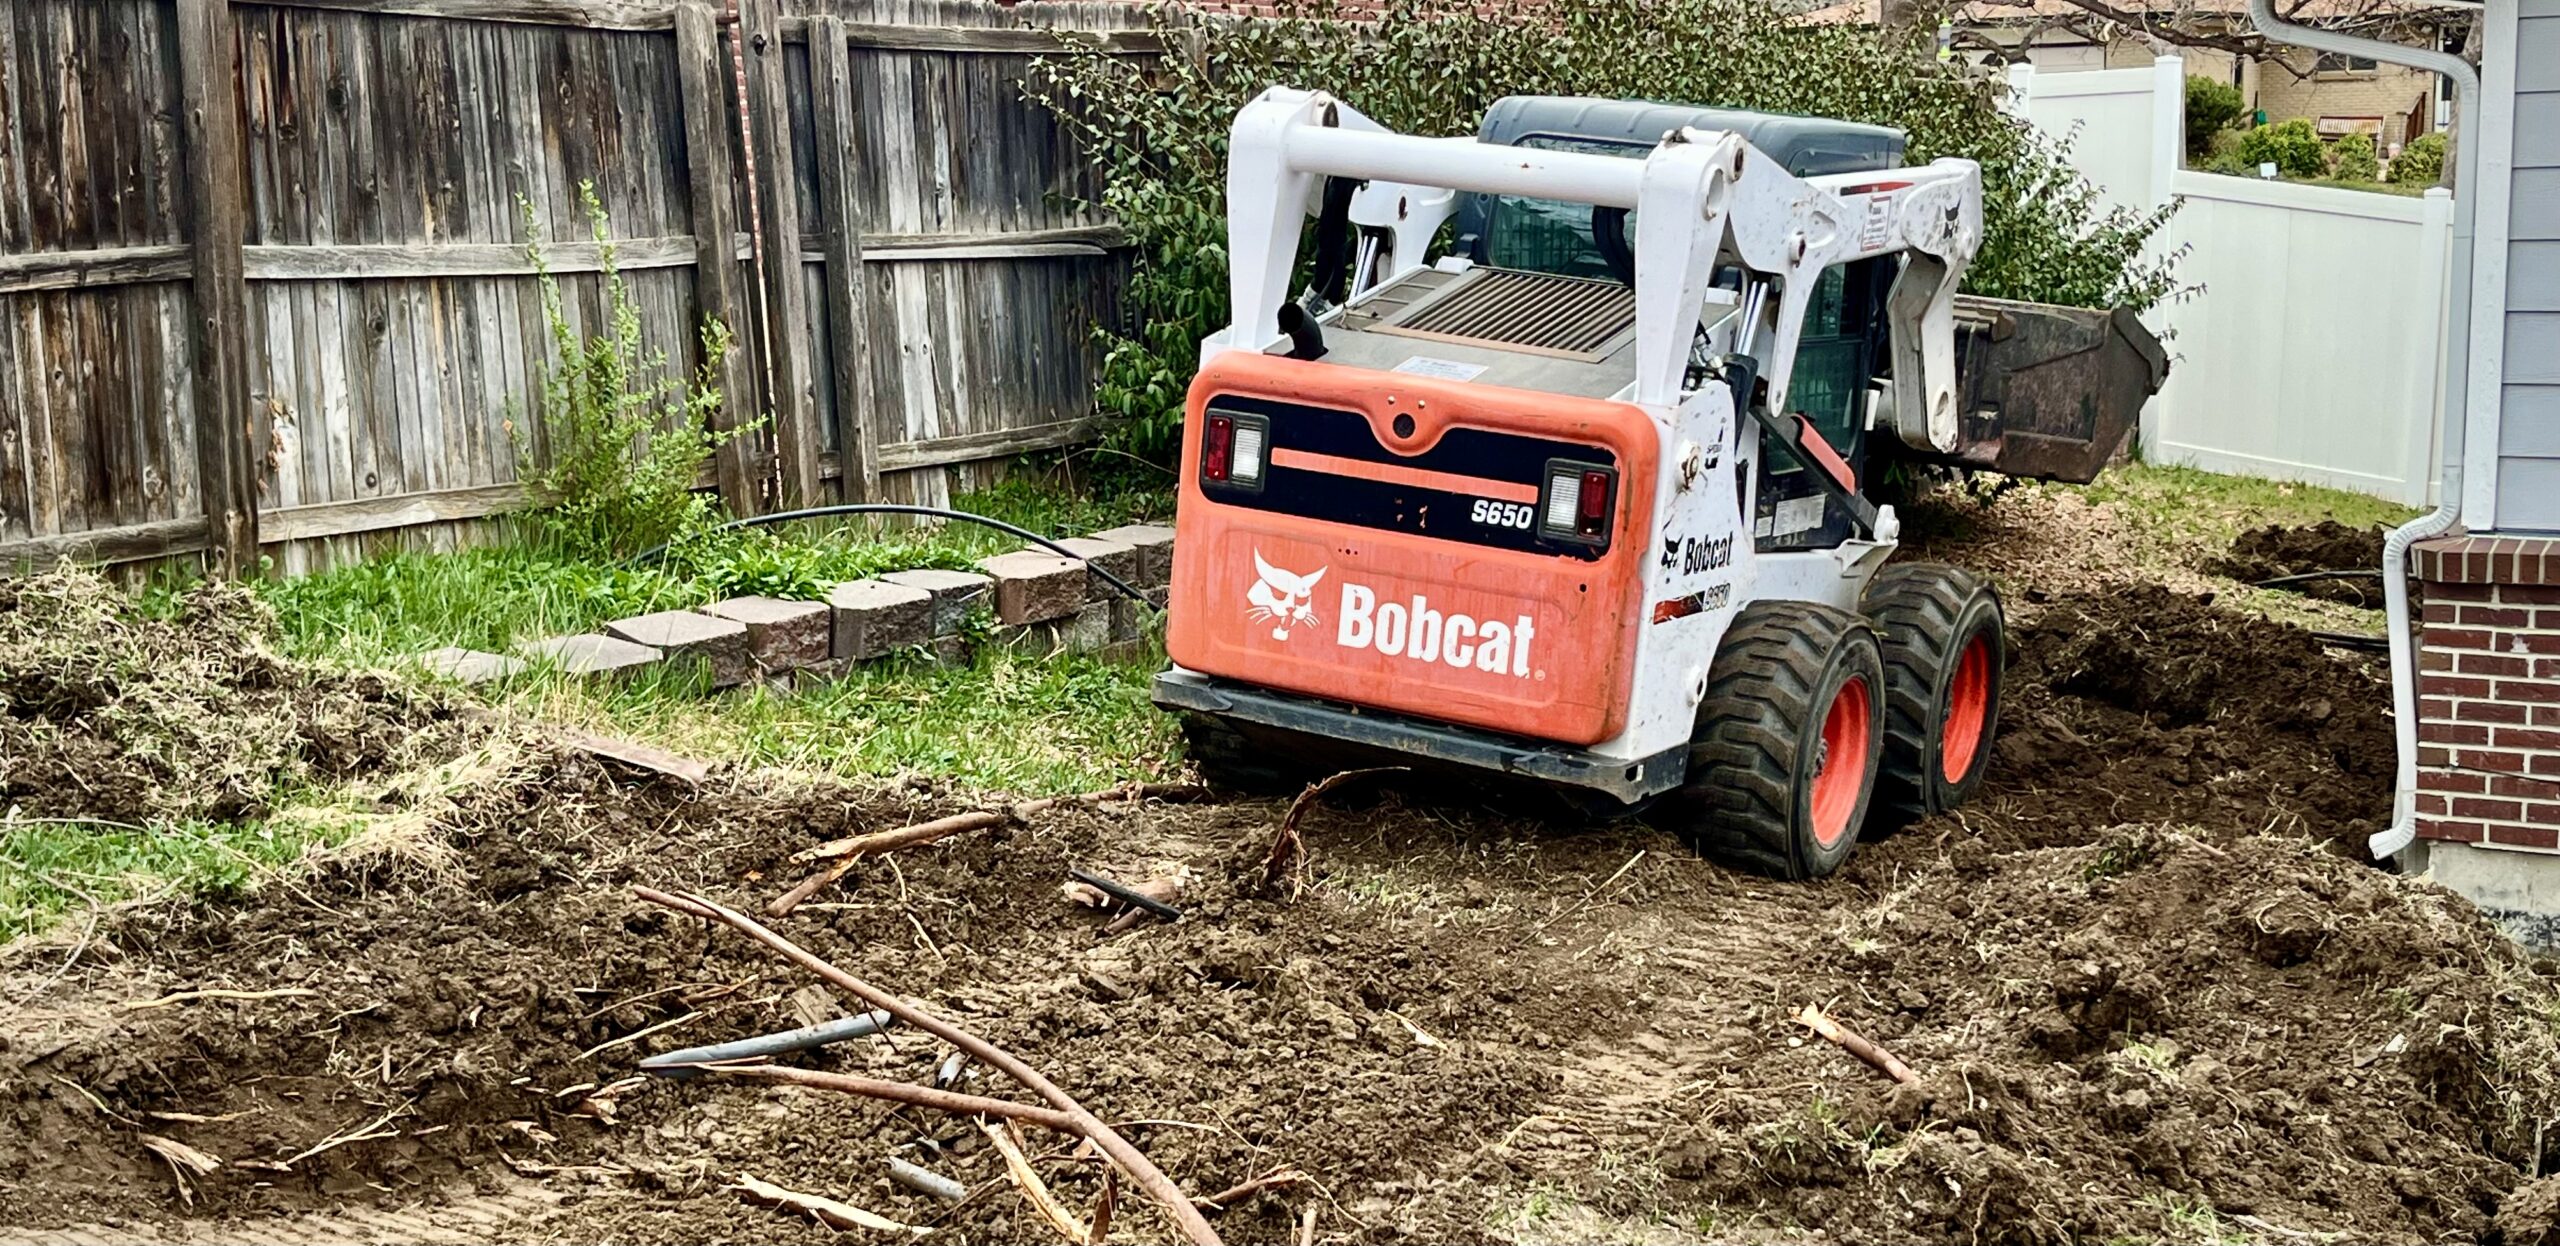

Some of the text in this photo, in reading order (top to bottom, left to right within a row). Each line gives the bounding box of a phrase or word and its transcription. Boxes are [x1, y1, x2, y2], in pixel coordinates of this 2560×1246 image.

[1471, 500, 1533, 529] S650
[1683, 531, 1733, 576] Bobcat
[1337, 583, 1535, 679] Bobcat
